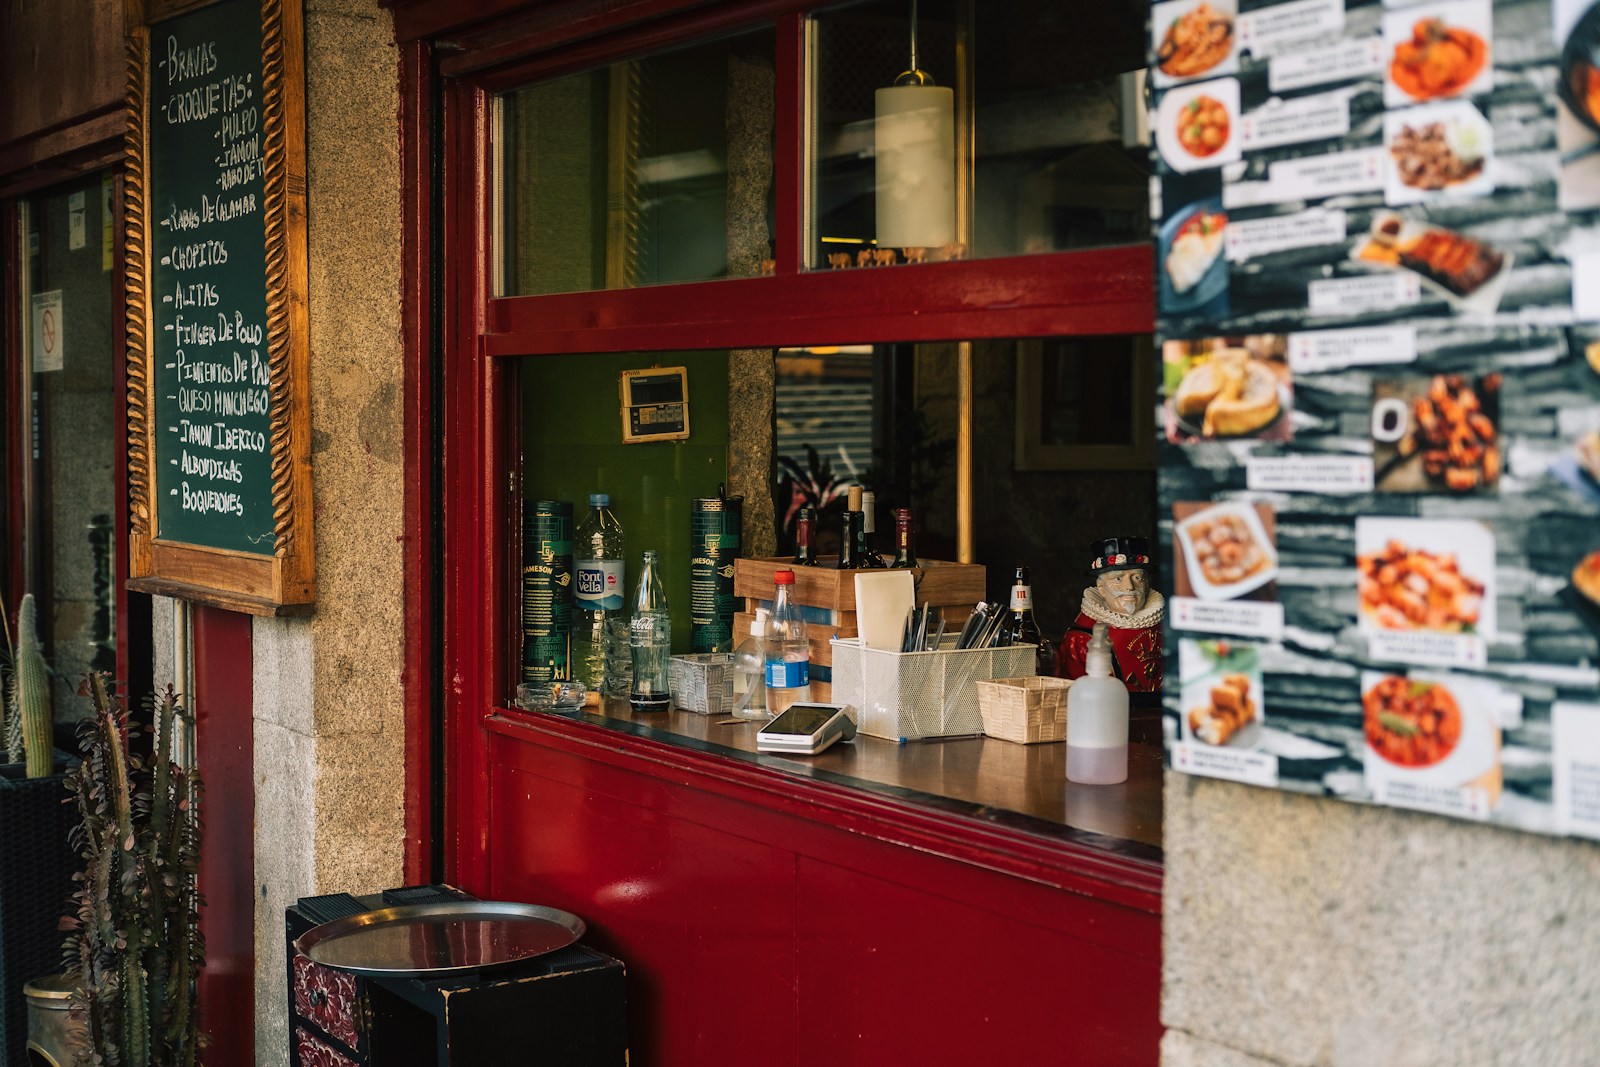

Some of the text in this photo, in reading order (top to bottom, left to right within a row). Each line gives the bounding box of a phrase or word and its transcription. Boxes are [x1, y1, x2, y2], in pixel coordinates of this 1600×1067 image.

[222, 106, 257, 147] PULPO
[221, 167, 243, 191] RABO
[243, 160, 255, 185] DE
[175, 281, 219, 309] ALITAS
[176, 315, 216, 347] FINGER
[179, 387, 212, 413] QUESO
[180, 420, 265, 452] JAMON IBERICO
[181, 449, 243, 483] ALBONDIGAS
[182, 481, 243, 516] BOQUERONES
[578, 571, 602, 582] Font
[578, 581, 602, 593] Vella
